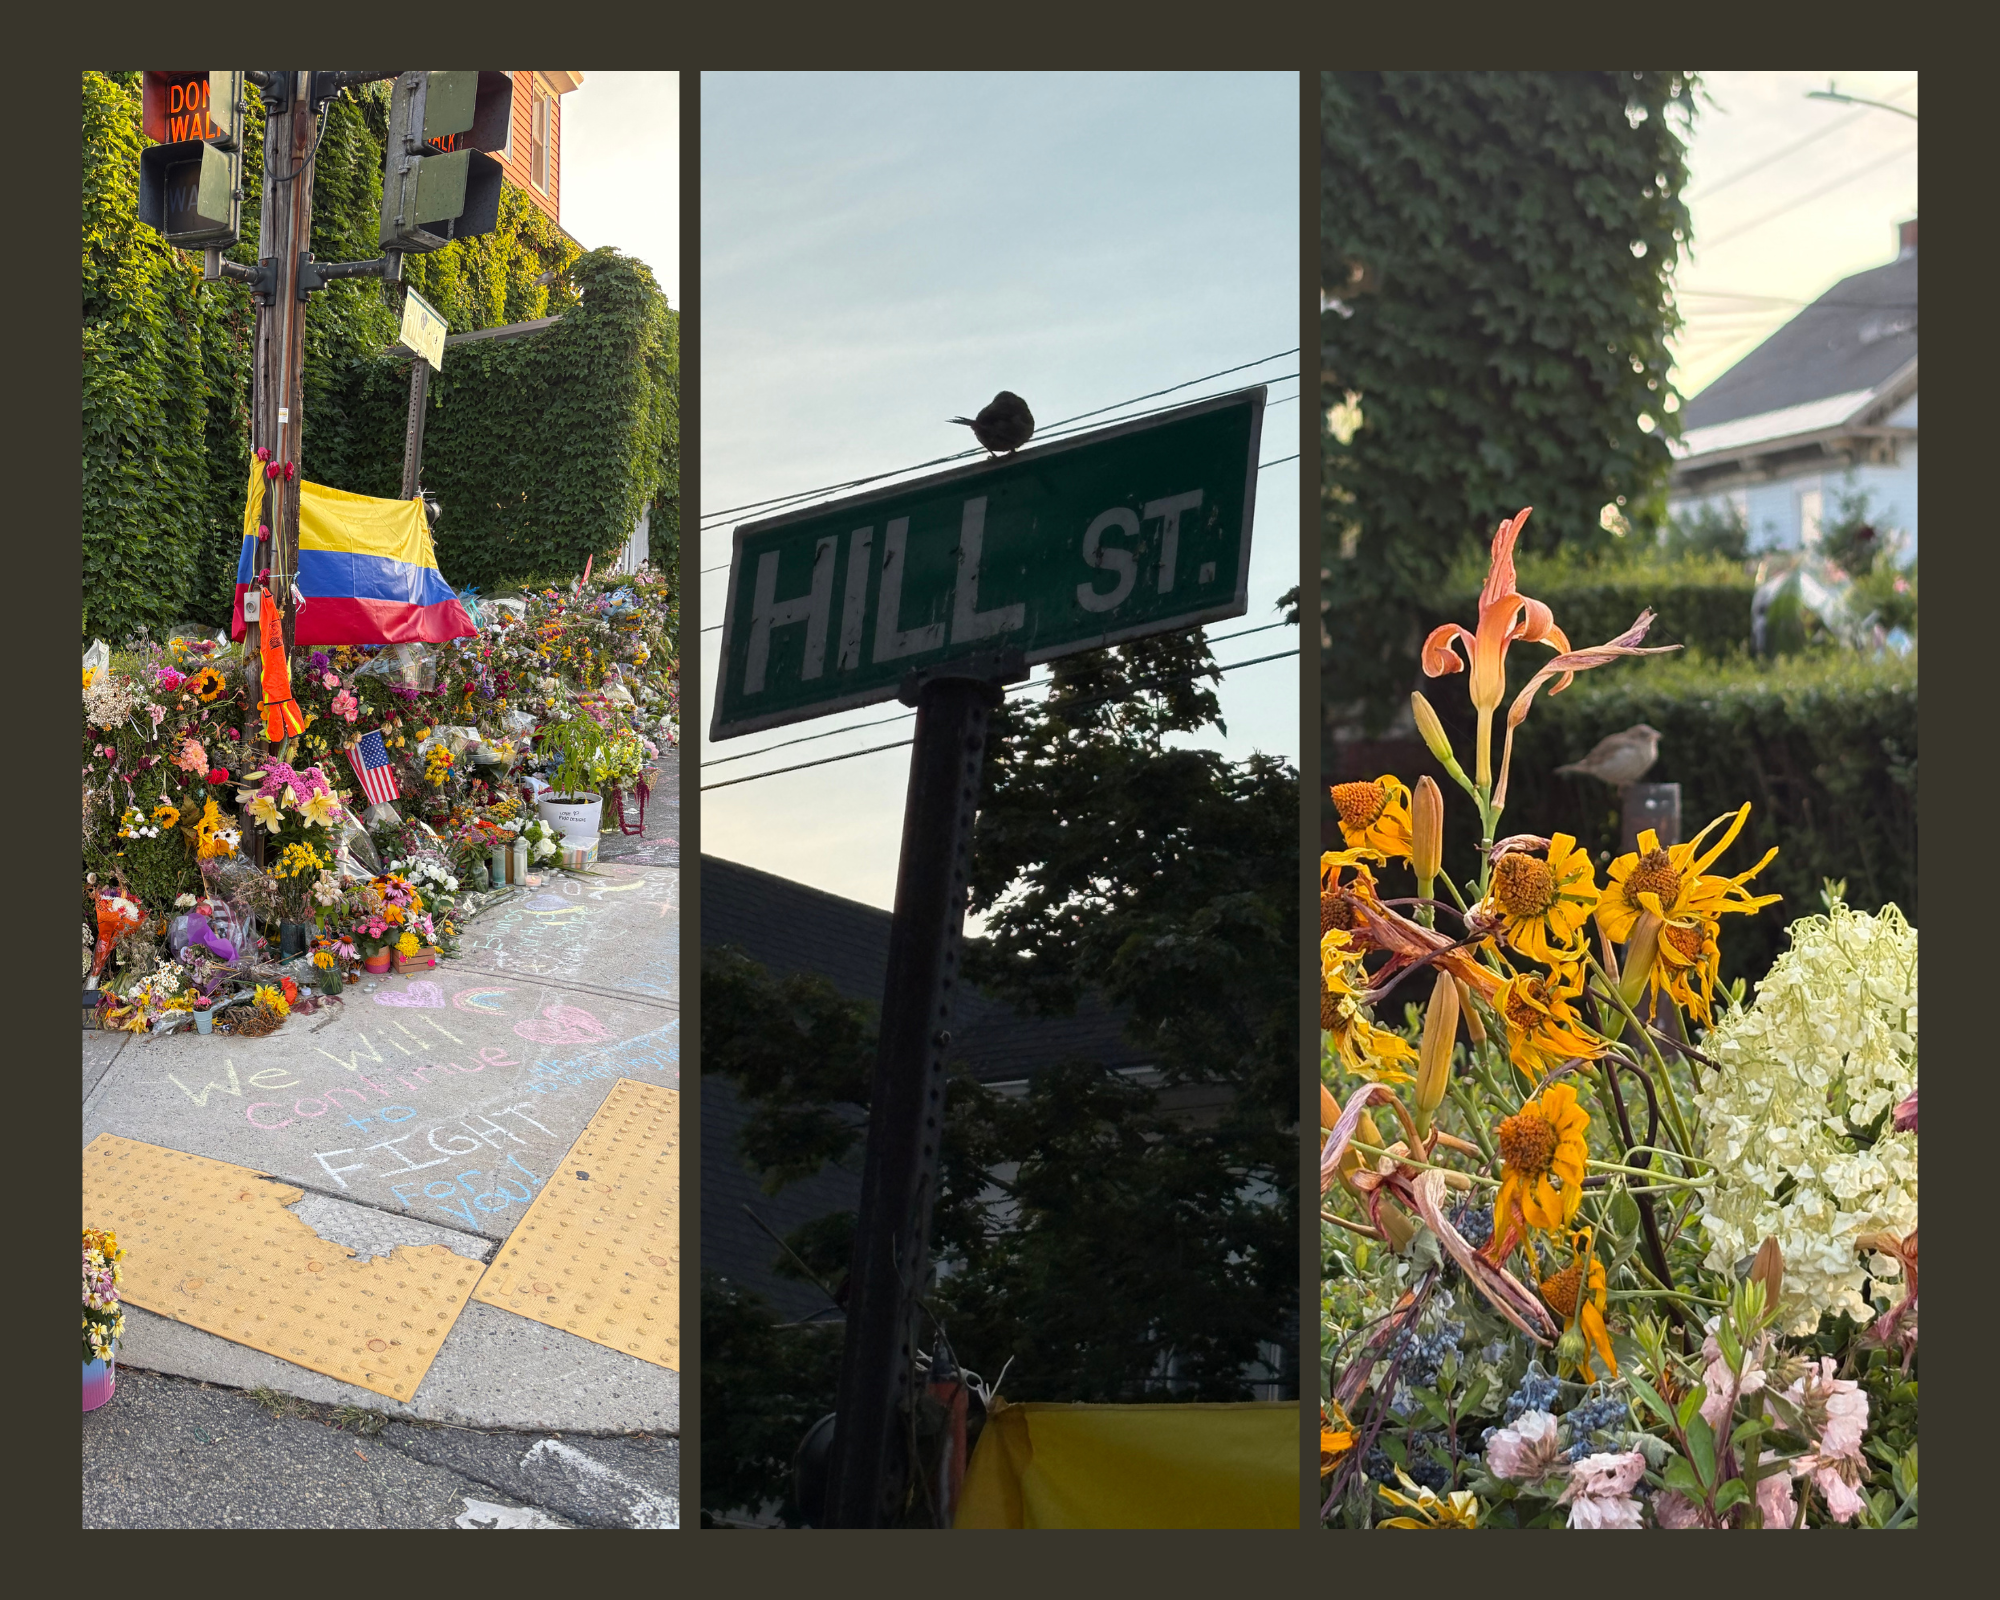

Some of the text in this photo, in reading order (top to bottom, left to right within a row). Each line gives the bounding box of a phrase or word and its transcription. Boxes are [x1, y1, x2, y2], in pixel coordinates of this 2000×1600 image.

[743, 488, 1216, 695] HILL ST.
[168, 1058, 300, 1107] We
[311, 1101, 558, 1189] FIGHT
[343, 1105, 417, 1134] to
